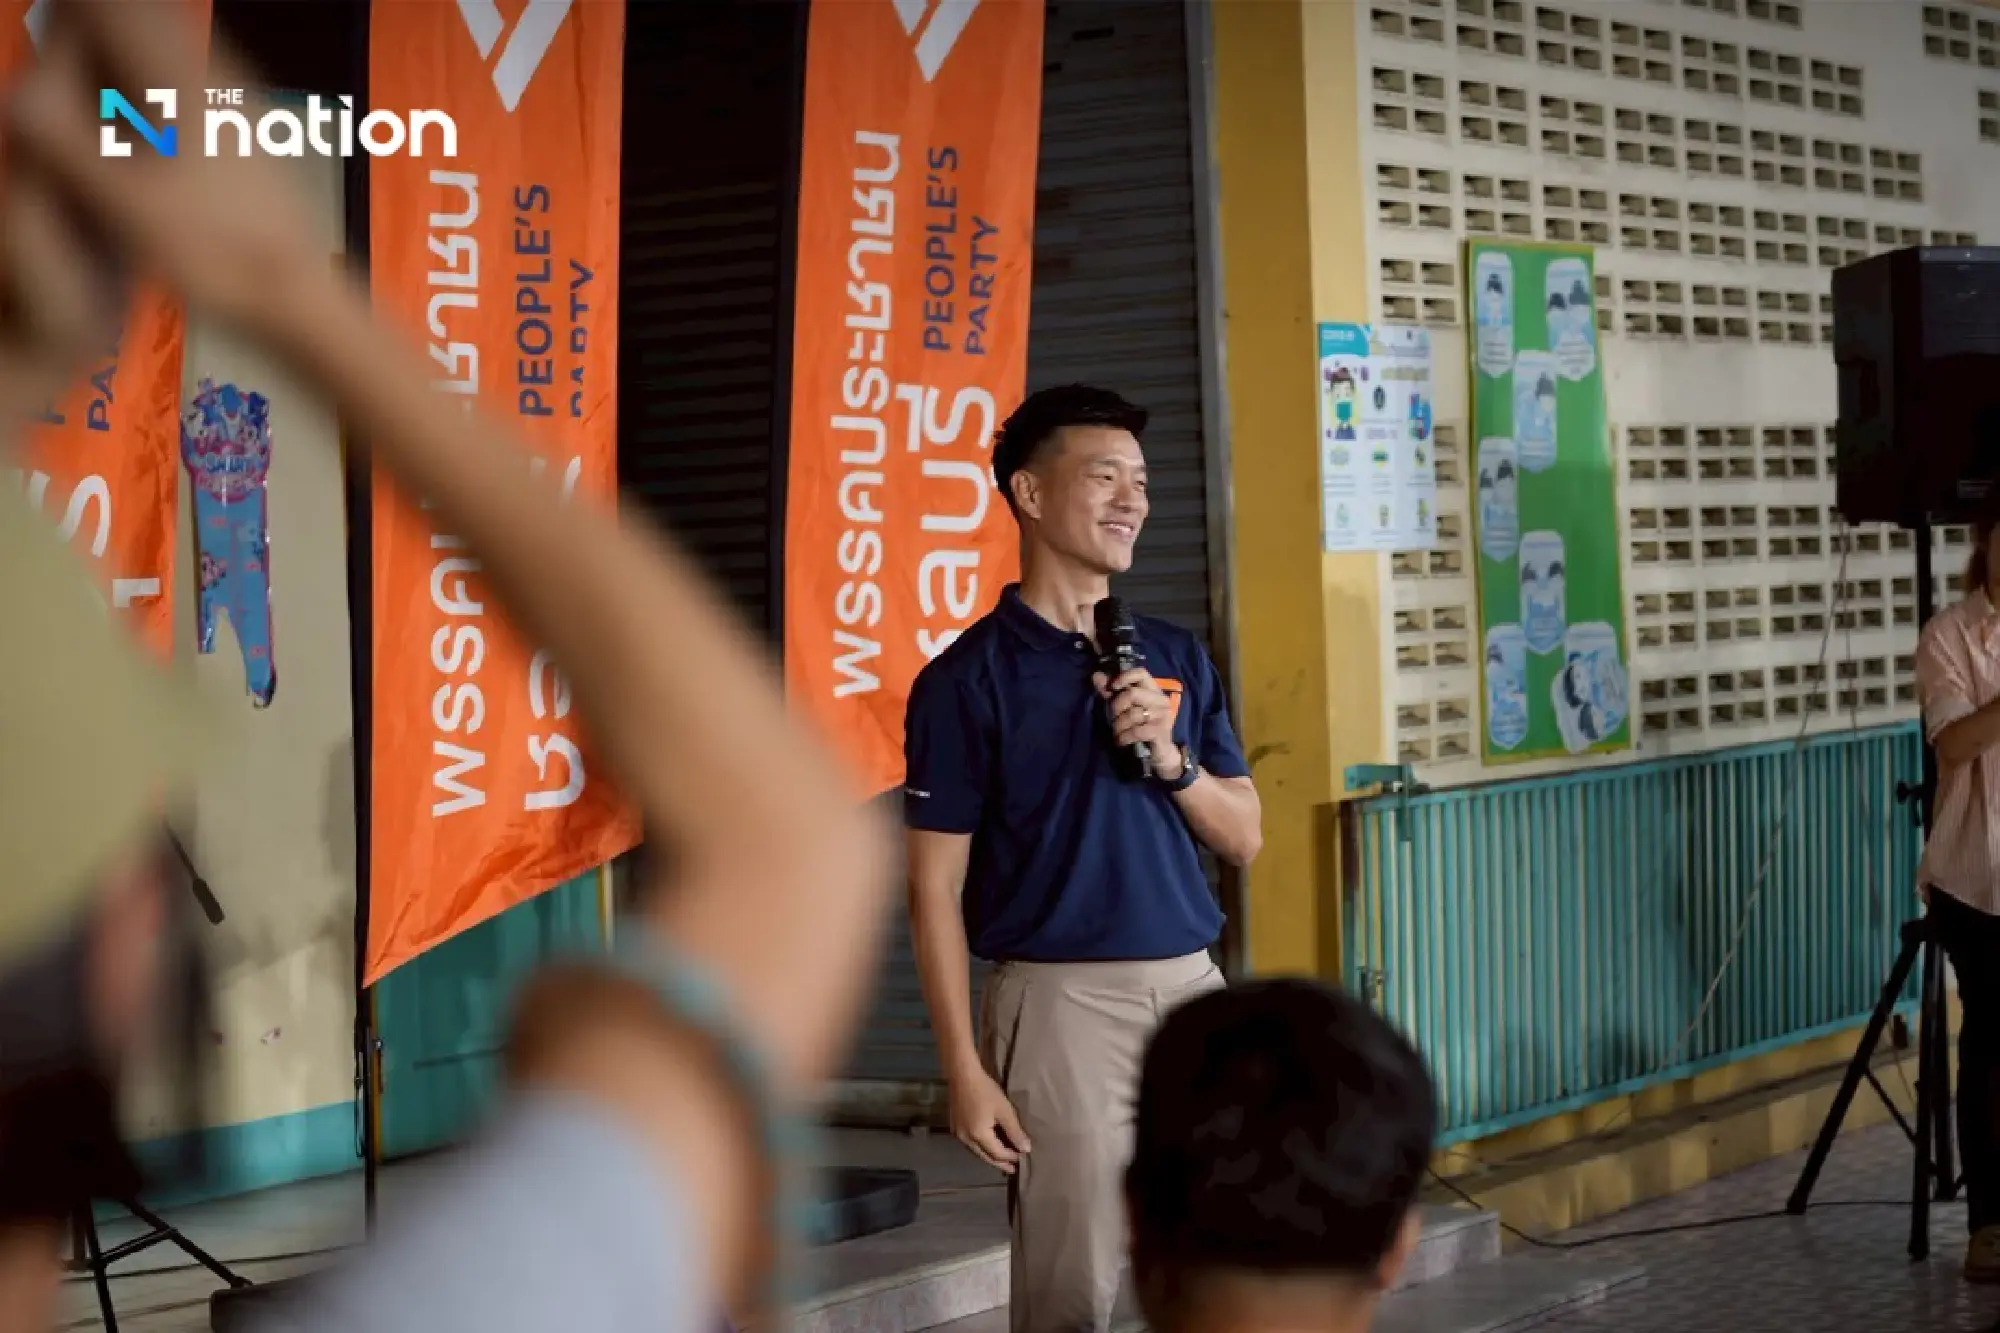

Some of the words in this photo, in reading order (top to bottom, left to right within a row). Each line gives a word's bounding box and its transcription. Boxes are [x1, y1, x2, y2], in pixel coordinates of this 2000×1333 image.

[514, 183, 553, 417] PEOPLE'S
[922, 146, 959, 352] PEOPLE'S
[963, 215, 999, 355] PARTY
[830, 130, 901, 698] พรรคประชาชน
